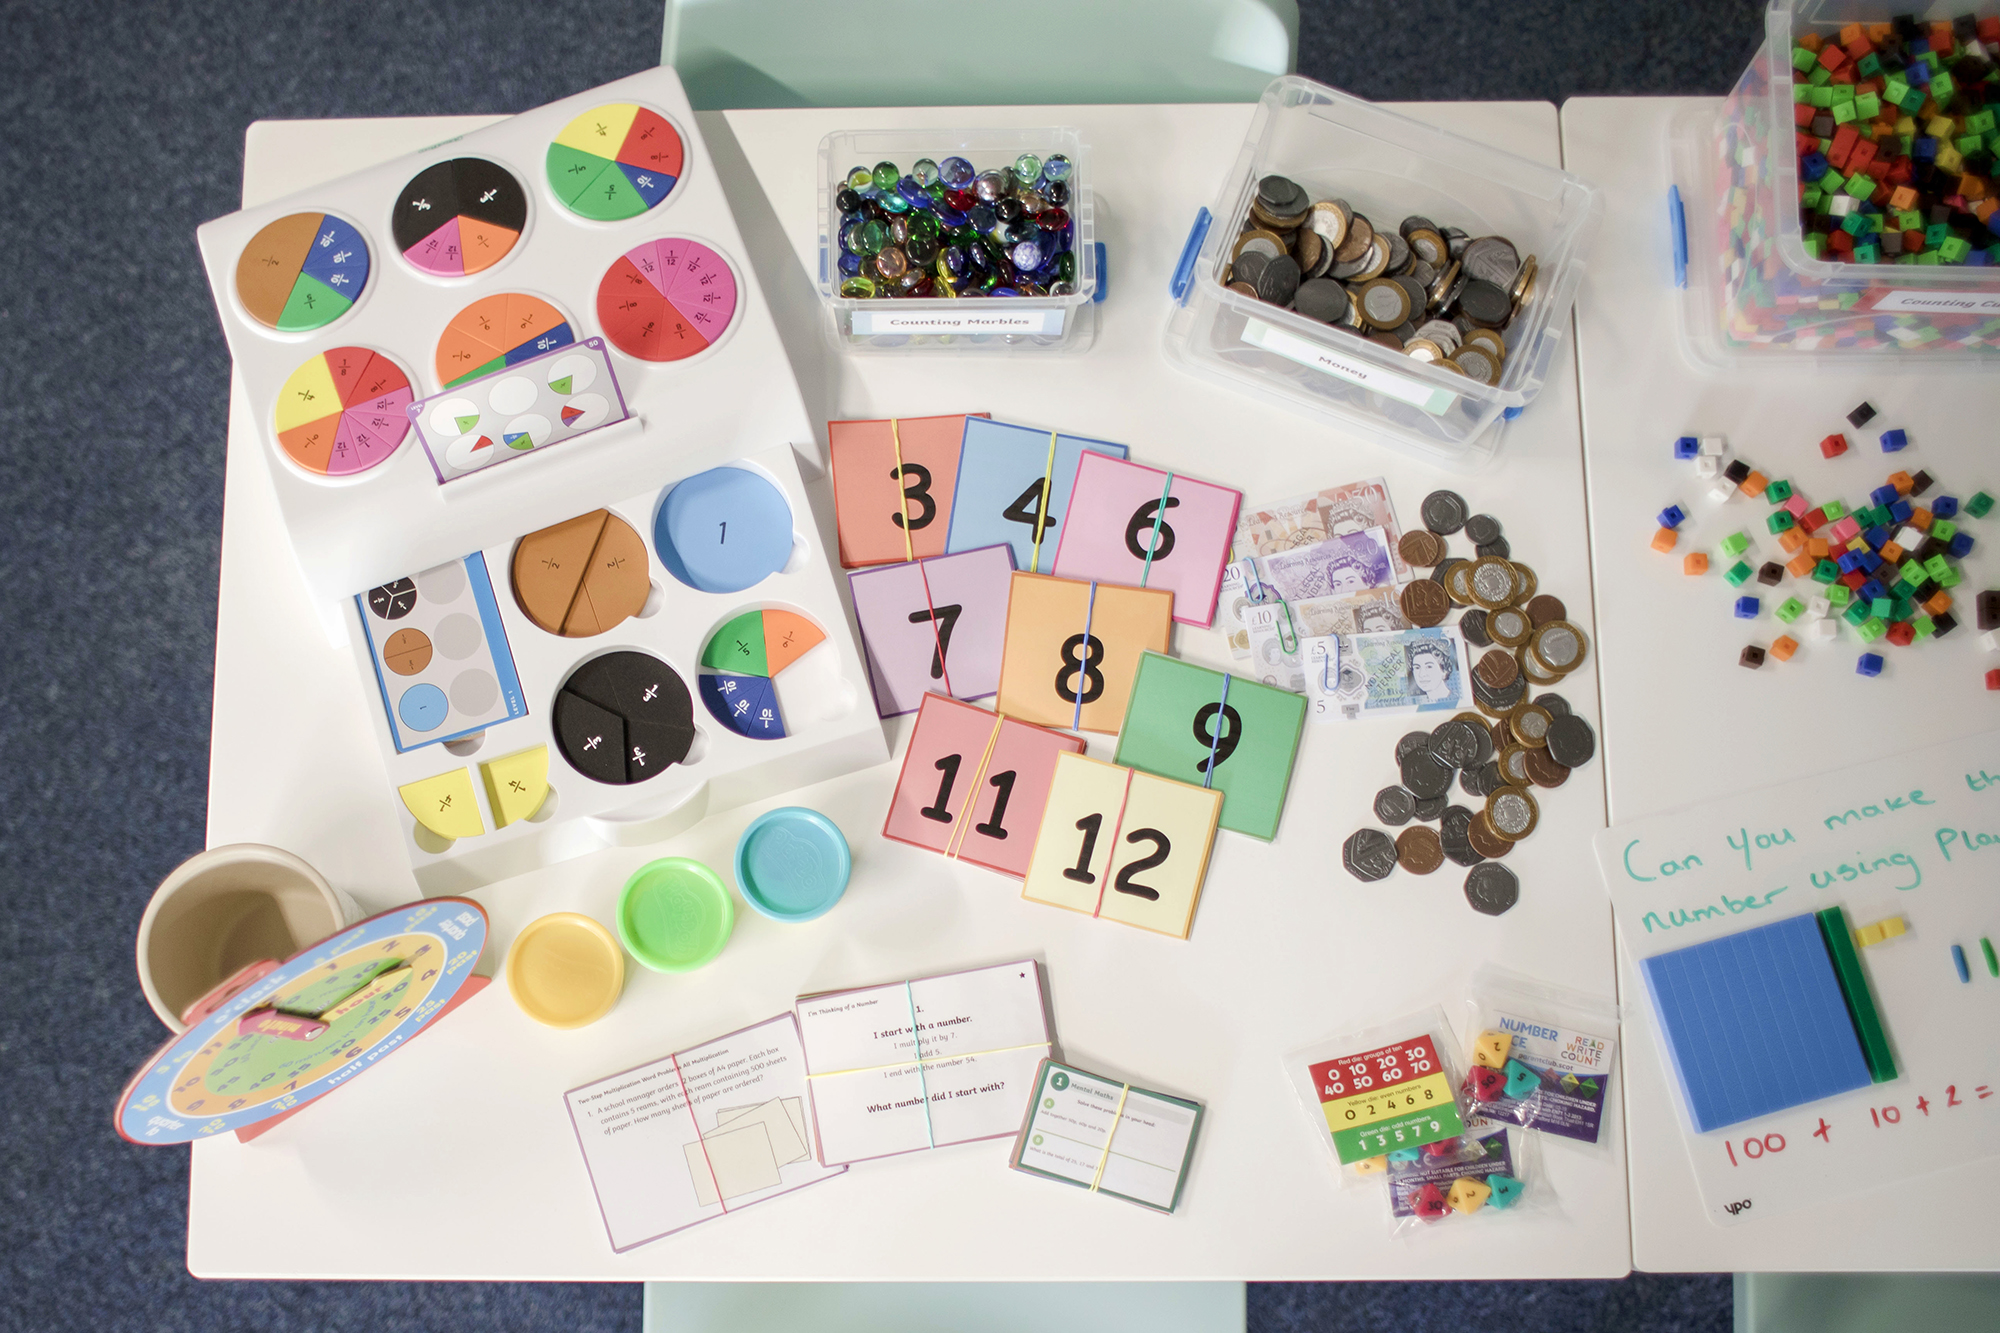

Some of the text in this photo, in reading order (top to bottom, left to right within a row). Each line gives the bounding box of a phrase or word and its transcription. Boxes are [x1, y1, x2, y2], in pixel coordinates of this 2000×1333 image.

[1900, 298, 1976, 308] Counting
[890, 318, 962, 326] Counting
[1318, 356, 1368, 380] Money
[890, 463, 936, 530] 3
[1003, 476, 1056, 545] 4
[1125, 496, 1180, 562] 6
[908, 604, 962, 680] 7
[1055, 633, 1105, 704] 8
[1380, 648, 1402, 676] LEGAL
[1376, 659, 1404, 693] TENDER
[1316, 700, 1326, 714] 5
[1192, 702, 1242, 774] 9
[920, 754, 1017, 840] 11
[1624, 839, 1703, 882] Can
[1823, 790, 1936, 830] make
[1062, 812, 1172, 902] 12
[1642, 886, 1789, 934] number
[1810, 852, 1922, 890] using
[335, 985, 384, 1016] hour
[394, 1006, 412, 1019] 5
[818, 999, 879, 1016] Thinking Number
[916, 1005, 924, 1013] 1.
[874, 1014, 973, 1040] I start wth a number.
[1500, 1017, 1558, 1042] NUMBER
[345, 1046, 362, 1058] 6
[899, 1034, 949, 1049] multply by
[919, 1049, 934, 1058] add
[1566, 1042, 1602, 1060] WRITE
[1575, 1036, 1604, 1050] READ
[328, 1034, 403, 1085] half past
[889, 1069, 903, 1078] end
[904, 1065, 921, 1075] with
[922, 1063, 935, 1072] the
[936, 1058, 964, 1070] number
[1328, 1046, 1426, 1080] 0 10 20 30
[1338, 1046, 1402, 1066] Red die: groups ten
[1518, 1053, 1574, 1072] parentclub.scot
[1560, 1050, 1600, 1067] COUNT
[283, 1080, 297, 1090] 7
[578, 1048, 730, 1106] Two-Step Multiplication Word Multiplication
[604, 1100, 626, 1112] school
[626, 1090, 656, 1106] manager
[657, 1080, 679, 1093] orders
[688, 1074, 708, 1085] boxes
[727, 1058, 748, 1072] paper.
[748, 1050, 766, 1063] Each
[766, 1046, 780, 1058] box
[1324, 1060, 1430, 1096] 40 50 60 70
[1481, 1074, 1496, 1089] 50
[1516, 1072, 1526, 1082] 5
[600, 1055, 788, 1126] contains reams, with ream containing 500 sheets
[866, 1102, 892, 1114] What
[931, 1093, 946, 1102] did
[955, 1086, 978, 1098] start
[980, 1081, 1006, 1093] with?
[1070, 1082, 1114, 1100] Mental Maths
[1348, 1084, 1422, 1107] Yellow die: even numbers
[228, 1098, 247, 1110] 8
[612, 1074, 764, 1134] paper. How many paper are ordered?
[1345, 1089, 1433, 1120] 0 2 4 6 8
[1358, 1120, 1440, 1150] 1 3 5 7 9
[1360, 1114, 1432, 1138] Green die: odd numbers
[1725, 1133, 1786, 1167] 100
[1870, 1106, 1900, 1128] 10
[1945, 1084, 1962, 1108] 2
[1431, 1168, 1454, 1176] SUITABLE
[1724, 1198, 1752, 1216] ypo
